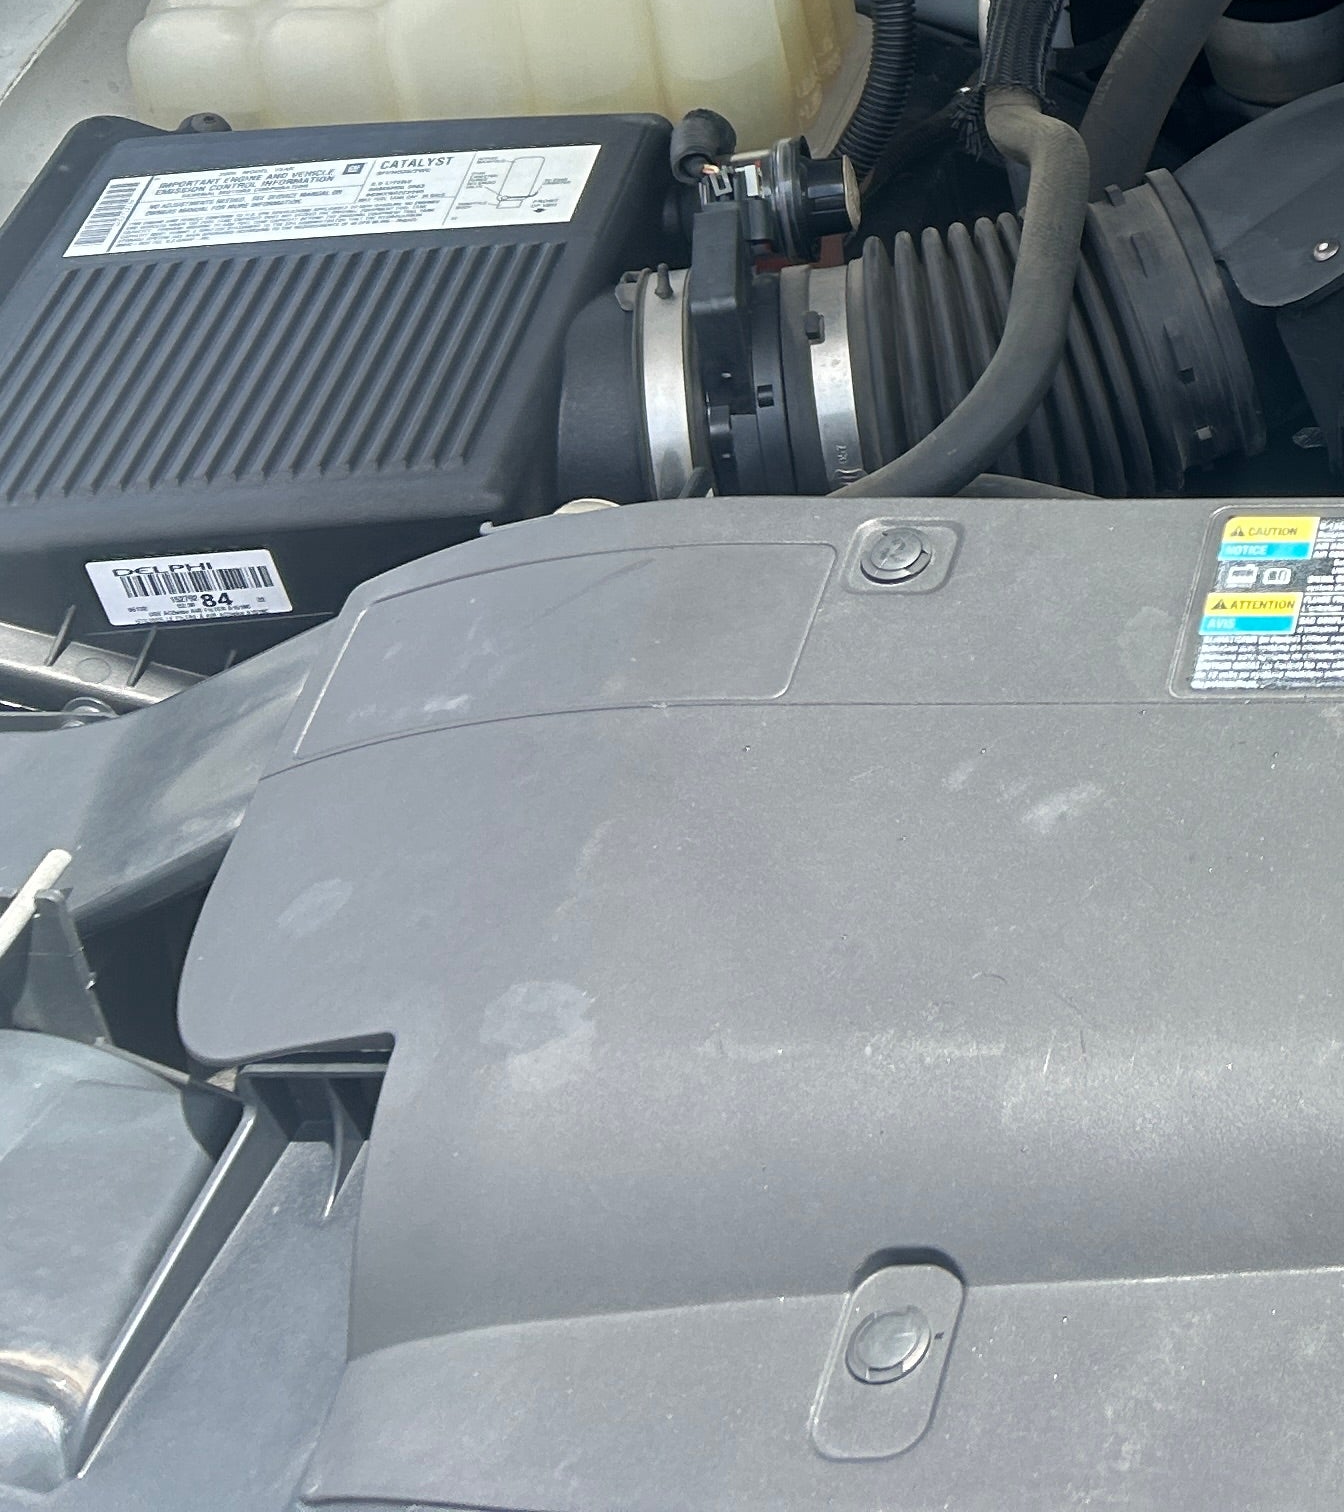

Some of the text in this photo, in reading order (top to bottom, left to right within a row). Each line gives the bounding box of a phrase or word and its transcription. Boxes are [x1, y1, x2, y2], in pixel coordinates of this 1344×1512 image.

[378, 155, 455, 170] CATALYST
[157, 178, 221, 189] IMPORTANT
[264, 172, 289, 180] AND
[207, 181, 259, 191] CONTROL
[259, 175, 336, 187] INFORMATION
[1248, 527, 1298, 536] CAUTION
[1225, 544, 1268, 556] NOTICE
[112, 562, 213, 577] DELPHI
[200, 592, 233, 608] 84
[1230, 600, 1295, 610] ATTENTION
[1207, 619, 1236, 630] AVIS
